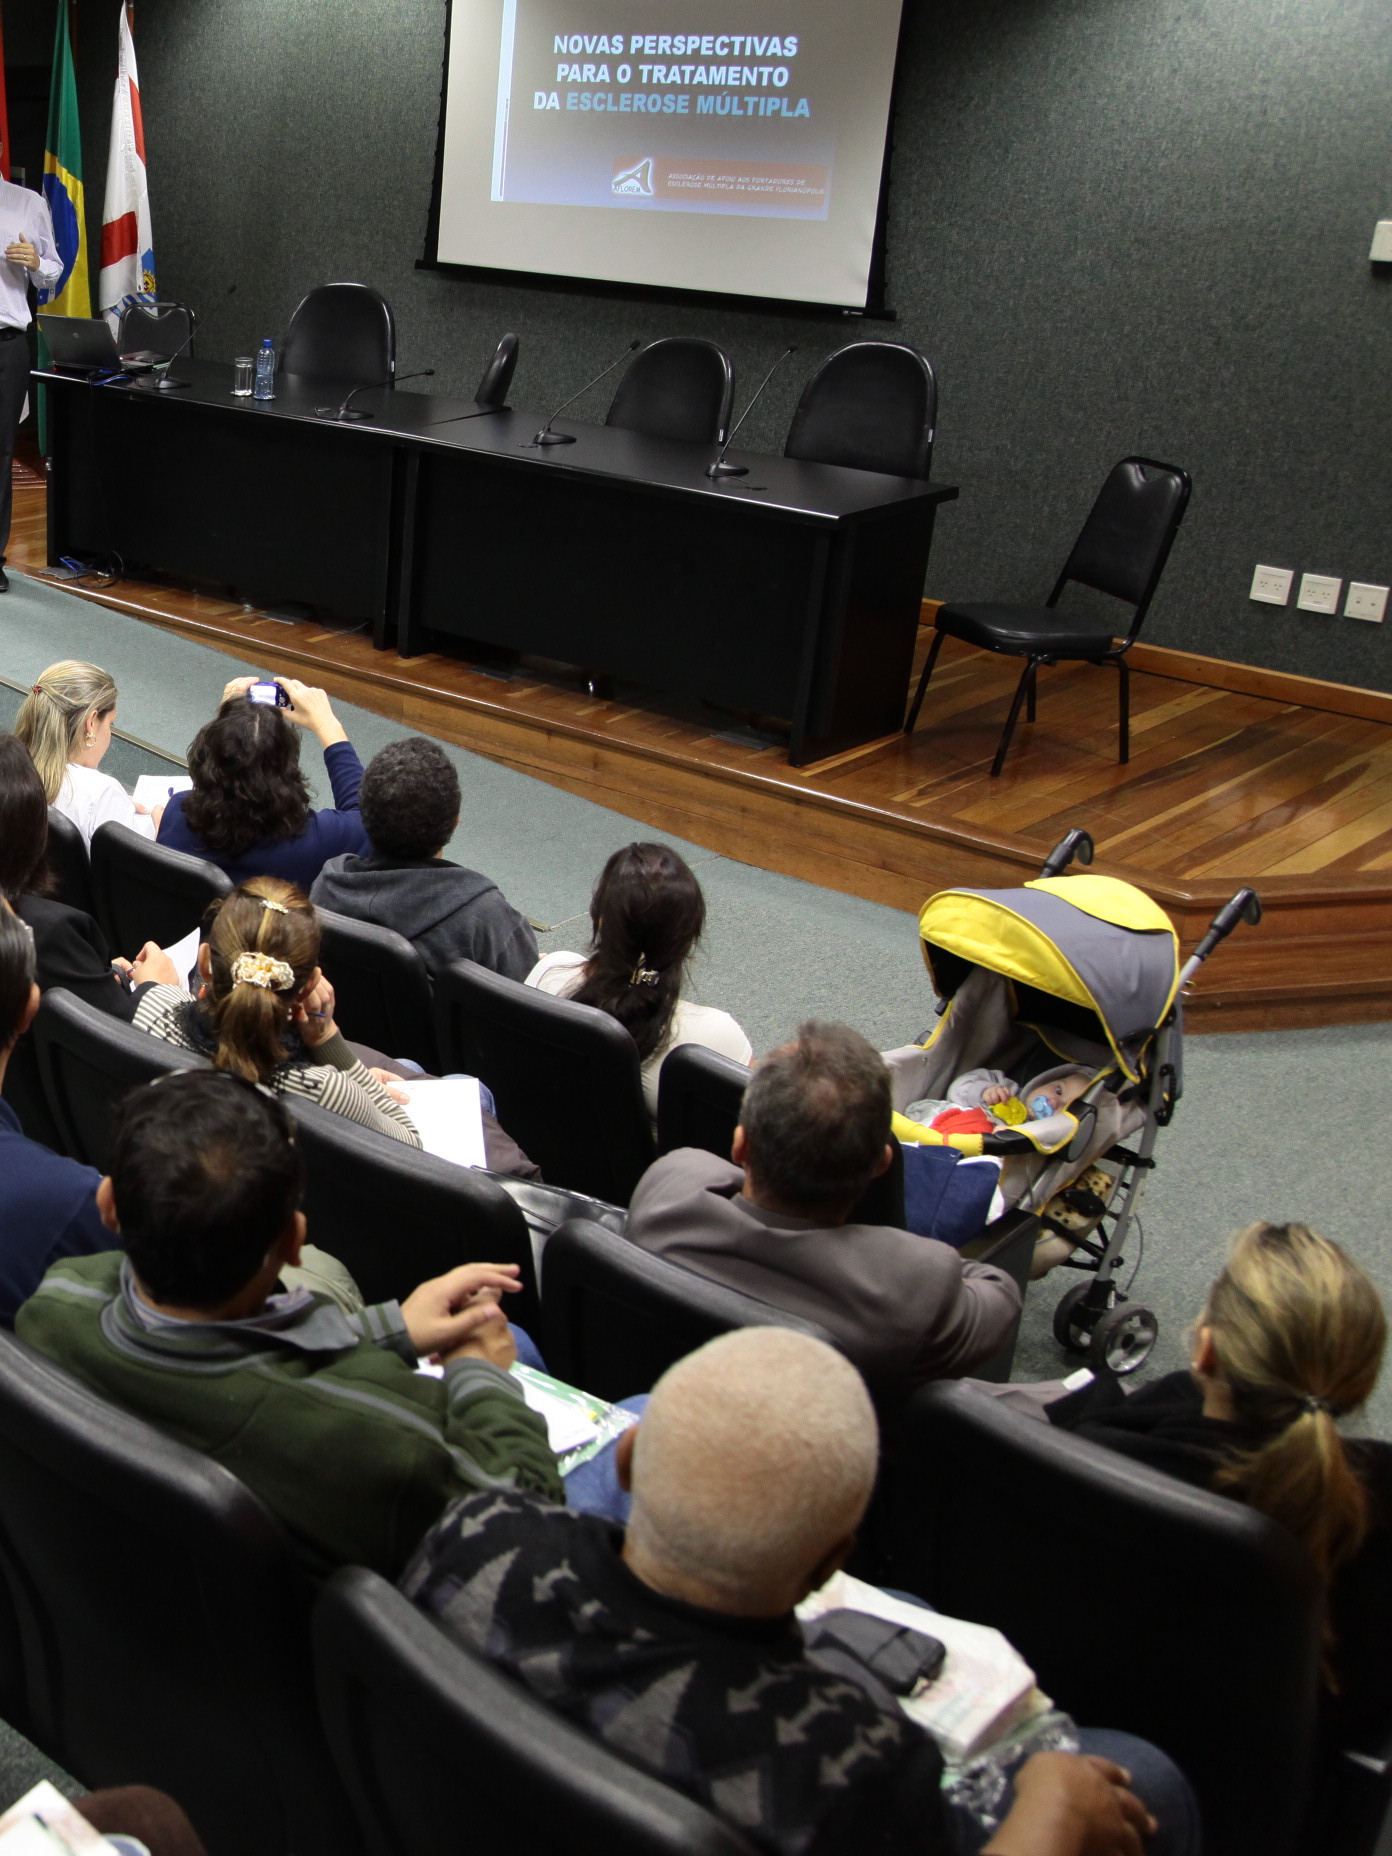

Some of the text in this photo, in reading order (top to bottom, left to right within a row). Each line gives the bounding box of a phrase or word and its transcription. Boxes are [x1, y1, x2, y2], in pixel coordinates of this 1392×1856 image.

[553, 34, 798, 57] NOVAS PERSPECTIVAS
[556, 64, 789, 87] PARA O TRATAMENTO
[533, 91, 810, 118] DA ESCLEROSE MÚLTIPLA
[668, 180, 702, 188] ESCLEROSE
